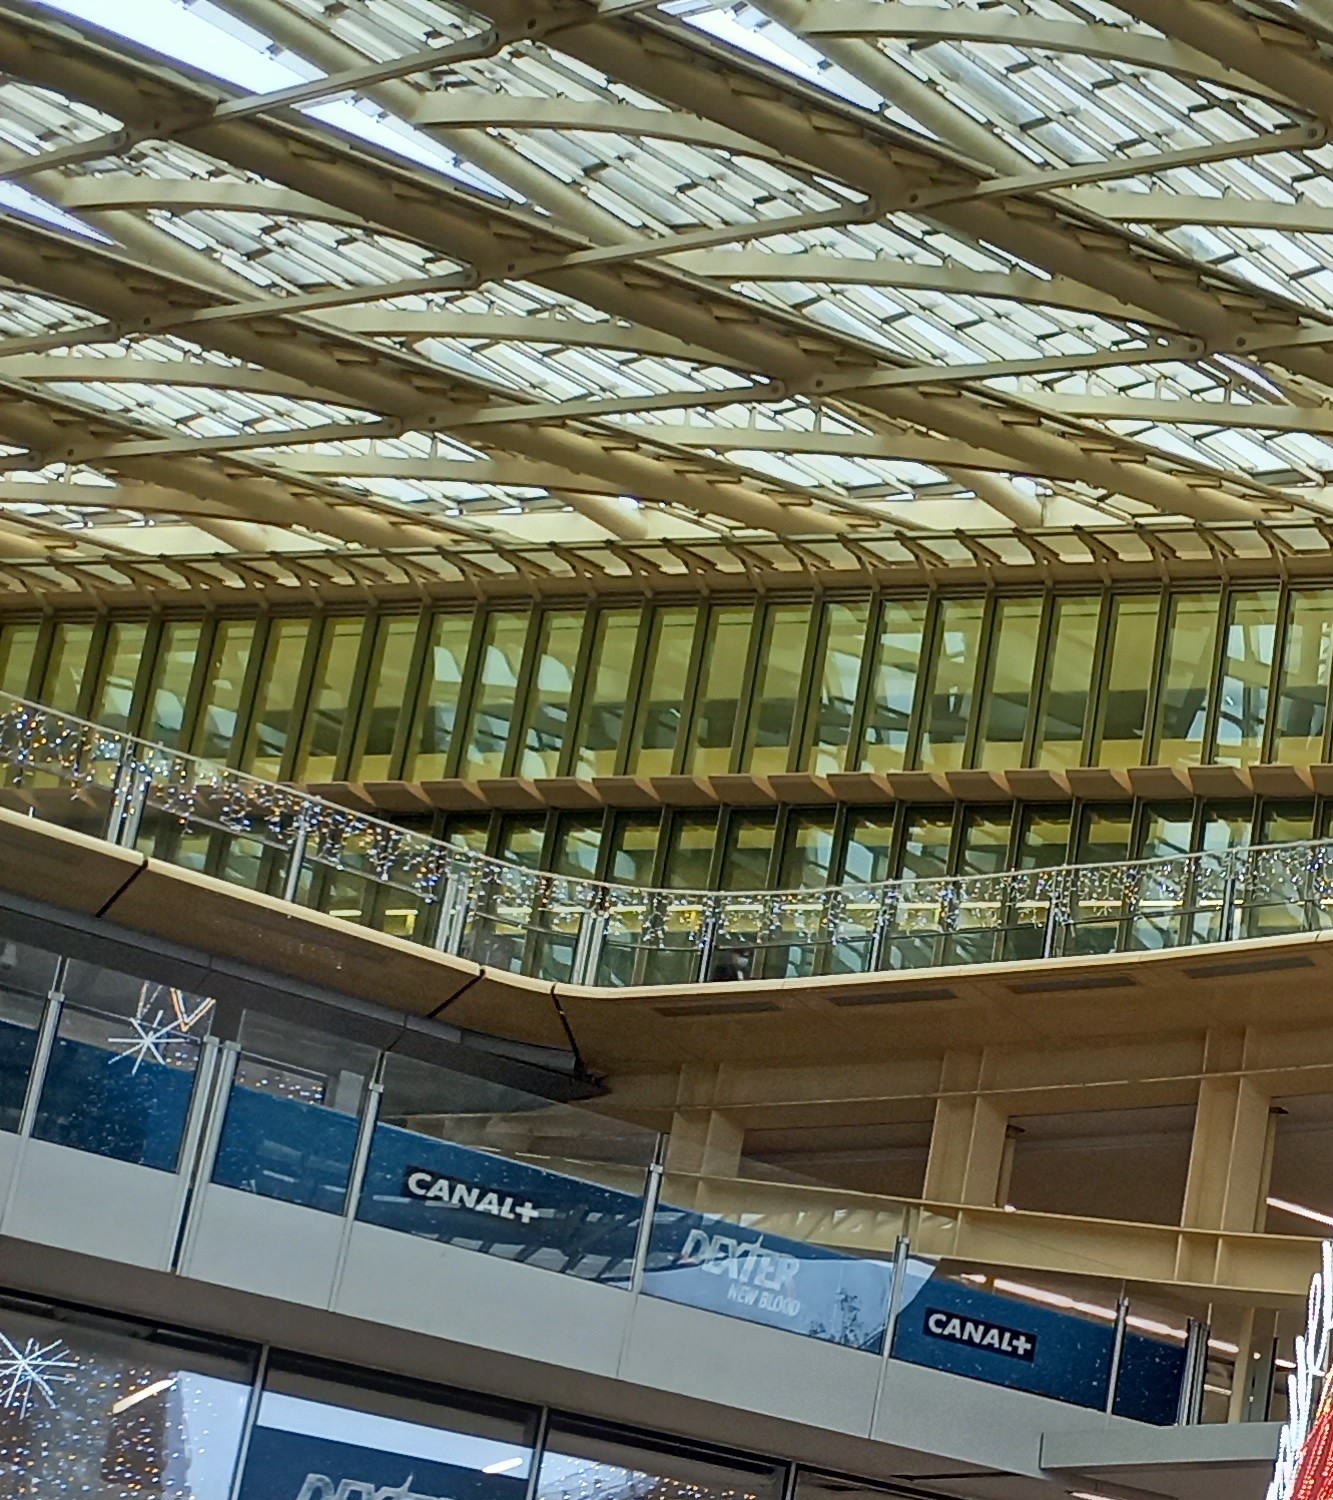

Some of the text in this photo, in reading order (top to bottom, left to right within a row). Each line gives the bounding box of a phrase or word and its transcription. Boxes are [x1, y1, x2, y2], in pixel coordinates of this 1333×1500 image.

[406, 1171, 540, 1224] CANAL+
[678, 1229, 801, 1292] DEXTER
[727, 1285, 800, 1317] NEW BLOOD
[927, 1313, 1032, 1356] CANAL+
